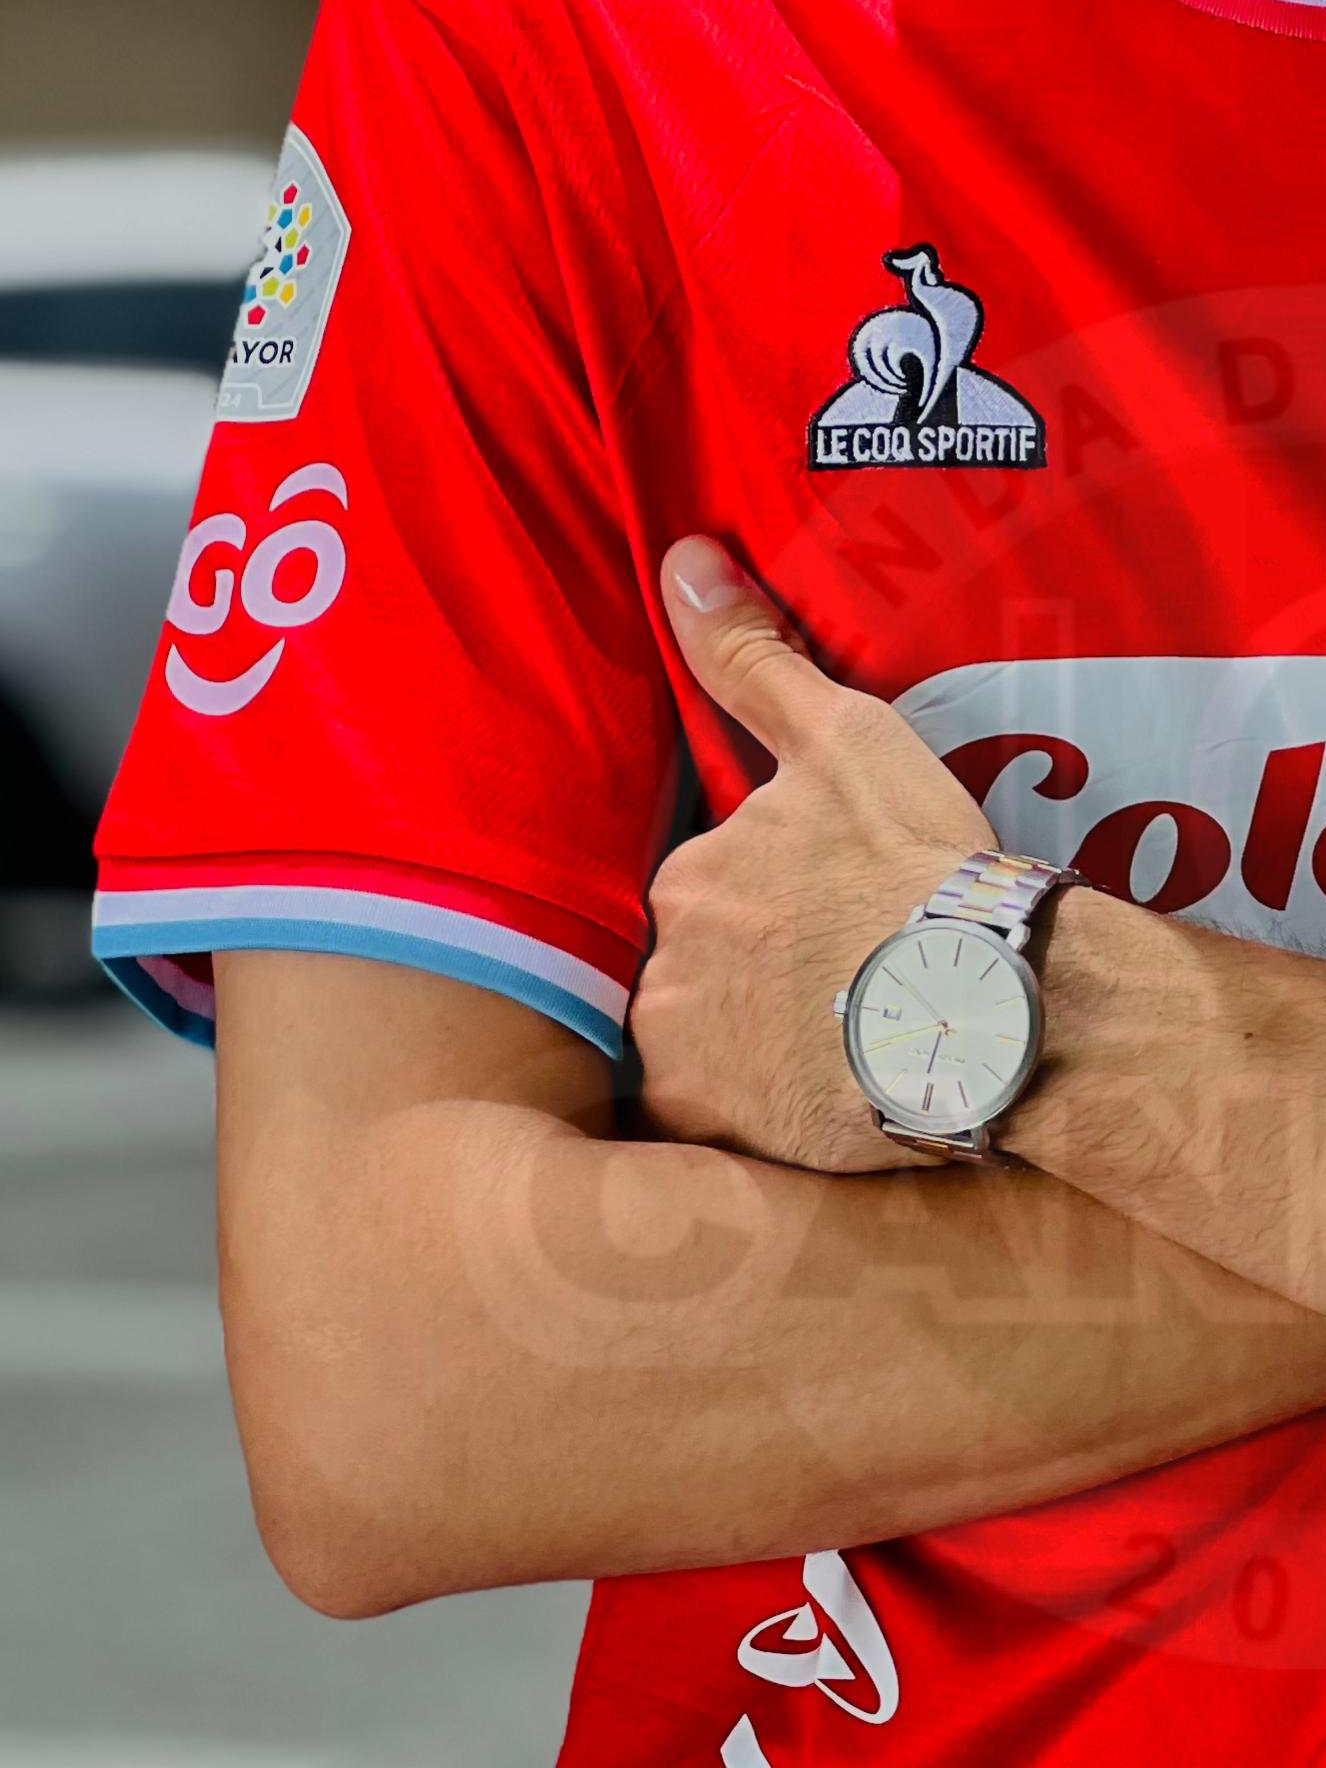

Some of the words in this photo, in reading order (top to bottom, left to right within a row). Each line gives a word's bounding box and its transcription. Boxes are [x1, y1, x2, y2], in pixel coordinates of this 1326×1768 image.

[815, 428, 848, 463] LE
[853, 426, 914, 463] COQ
[916, 425, 1037, 462] SPORTIF
